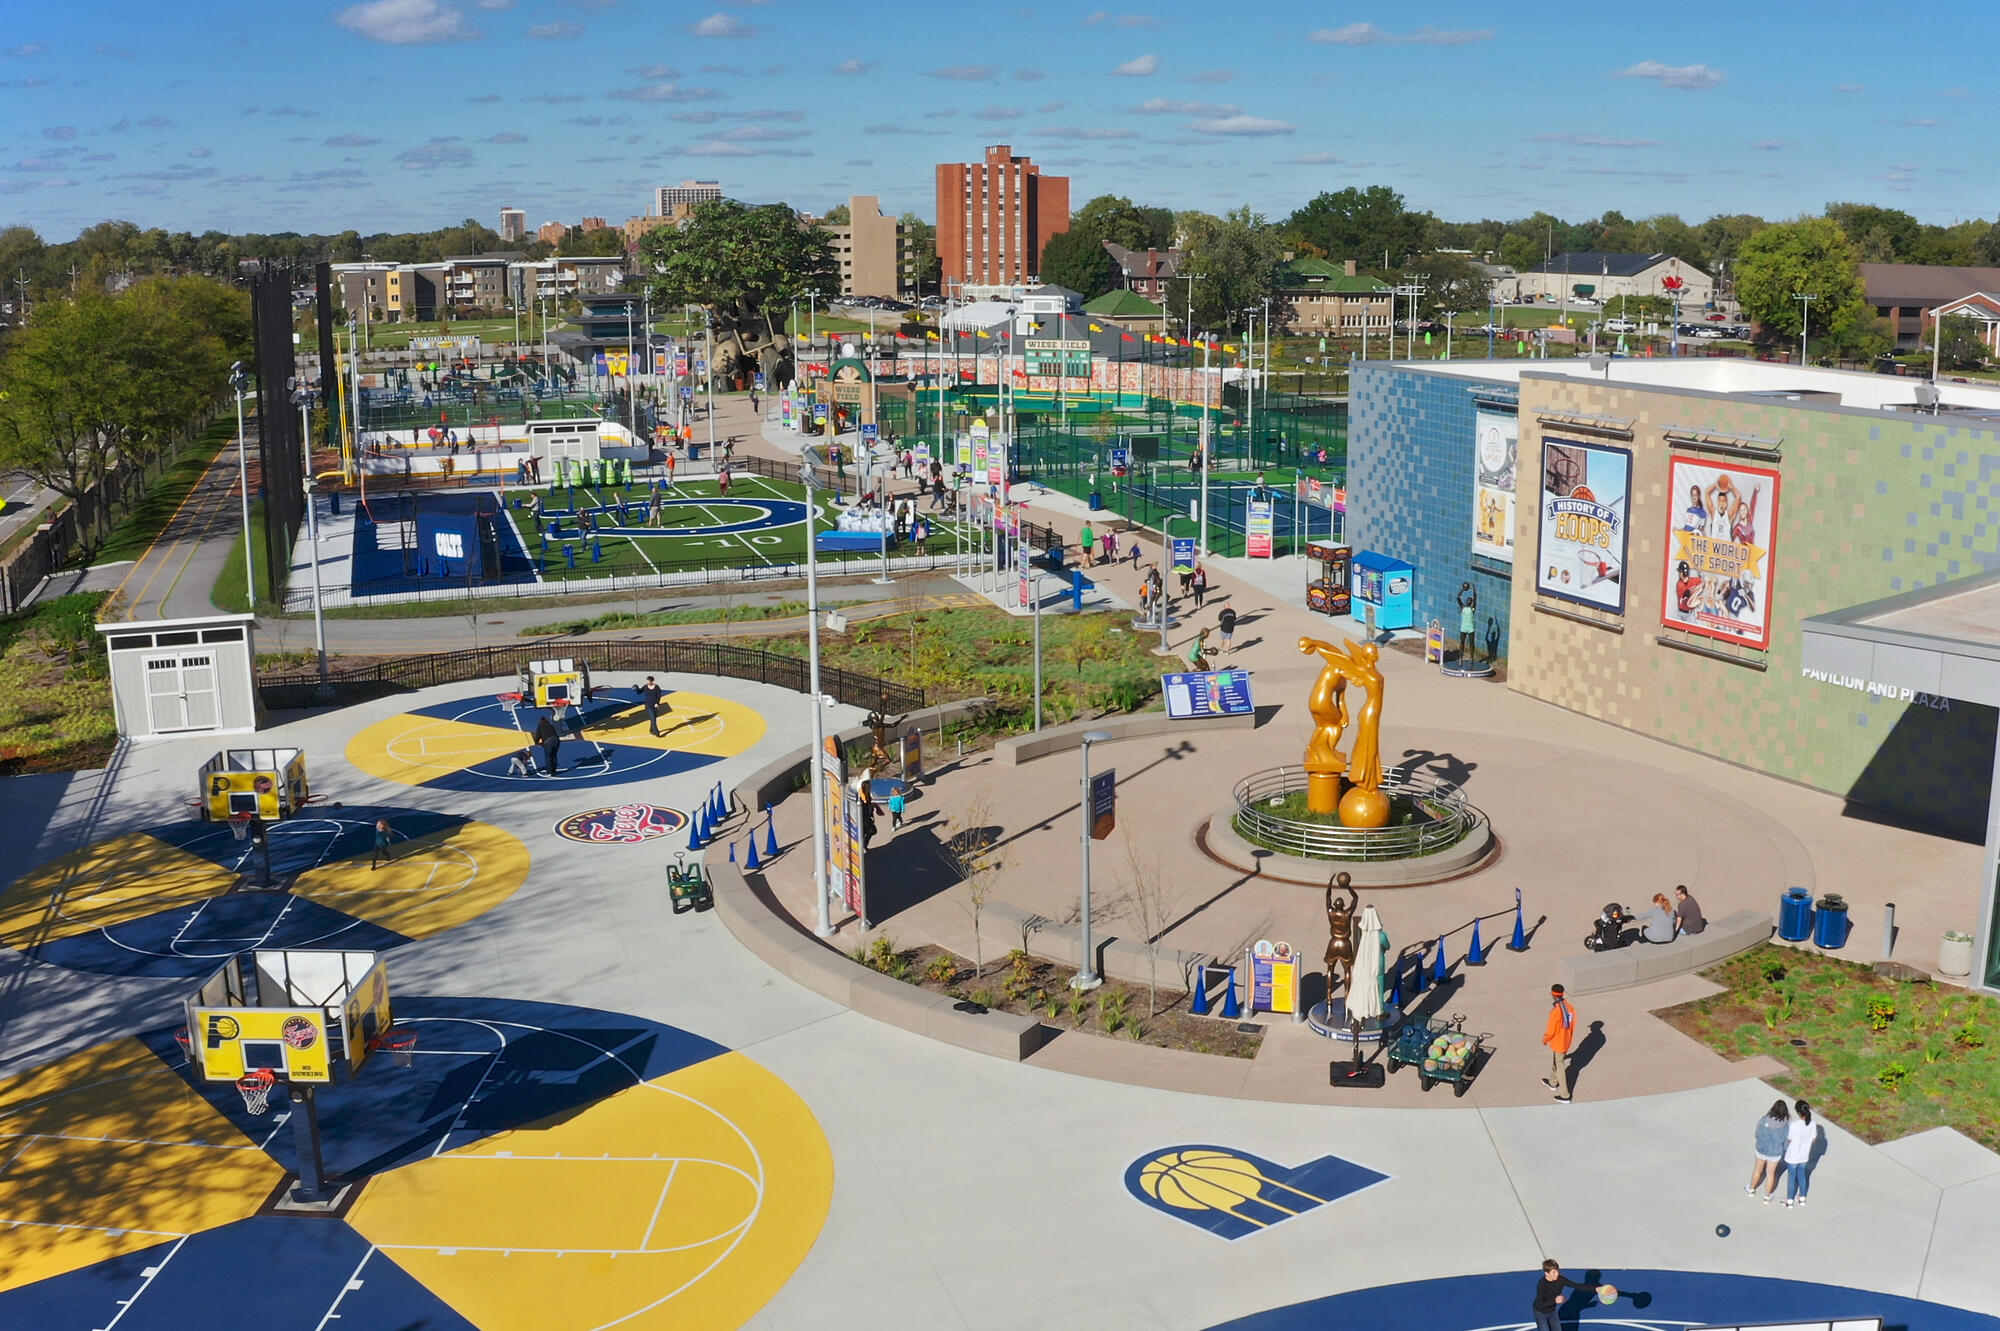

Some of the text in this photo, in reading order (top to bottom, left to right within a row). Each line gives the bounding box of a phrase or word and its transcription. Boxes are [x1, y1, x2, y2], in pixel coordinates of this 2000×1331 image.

[835, 385, 861, 401] WIESE FIELD
[1557, 502, 1610, 519] HISTORY OF
[1555, 512, 1611, 549] HOOPS
[435, 532, 464, 558] COLTS
[1690, 538, 1748, 561] THE WORLD
[1693, 554, 1743, 577] OF SPORT
[1802, 668, 1951, 712] PAVILION AND PLAZA
